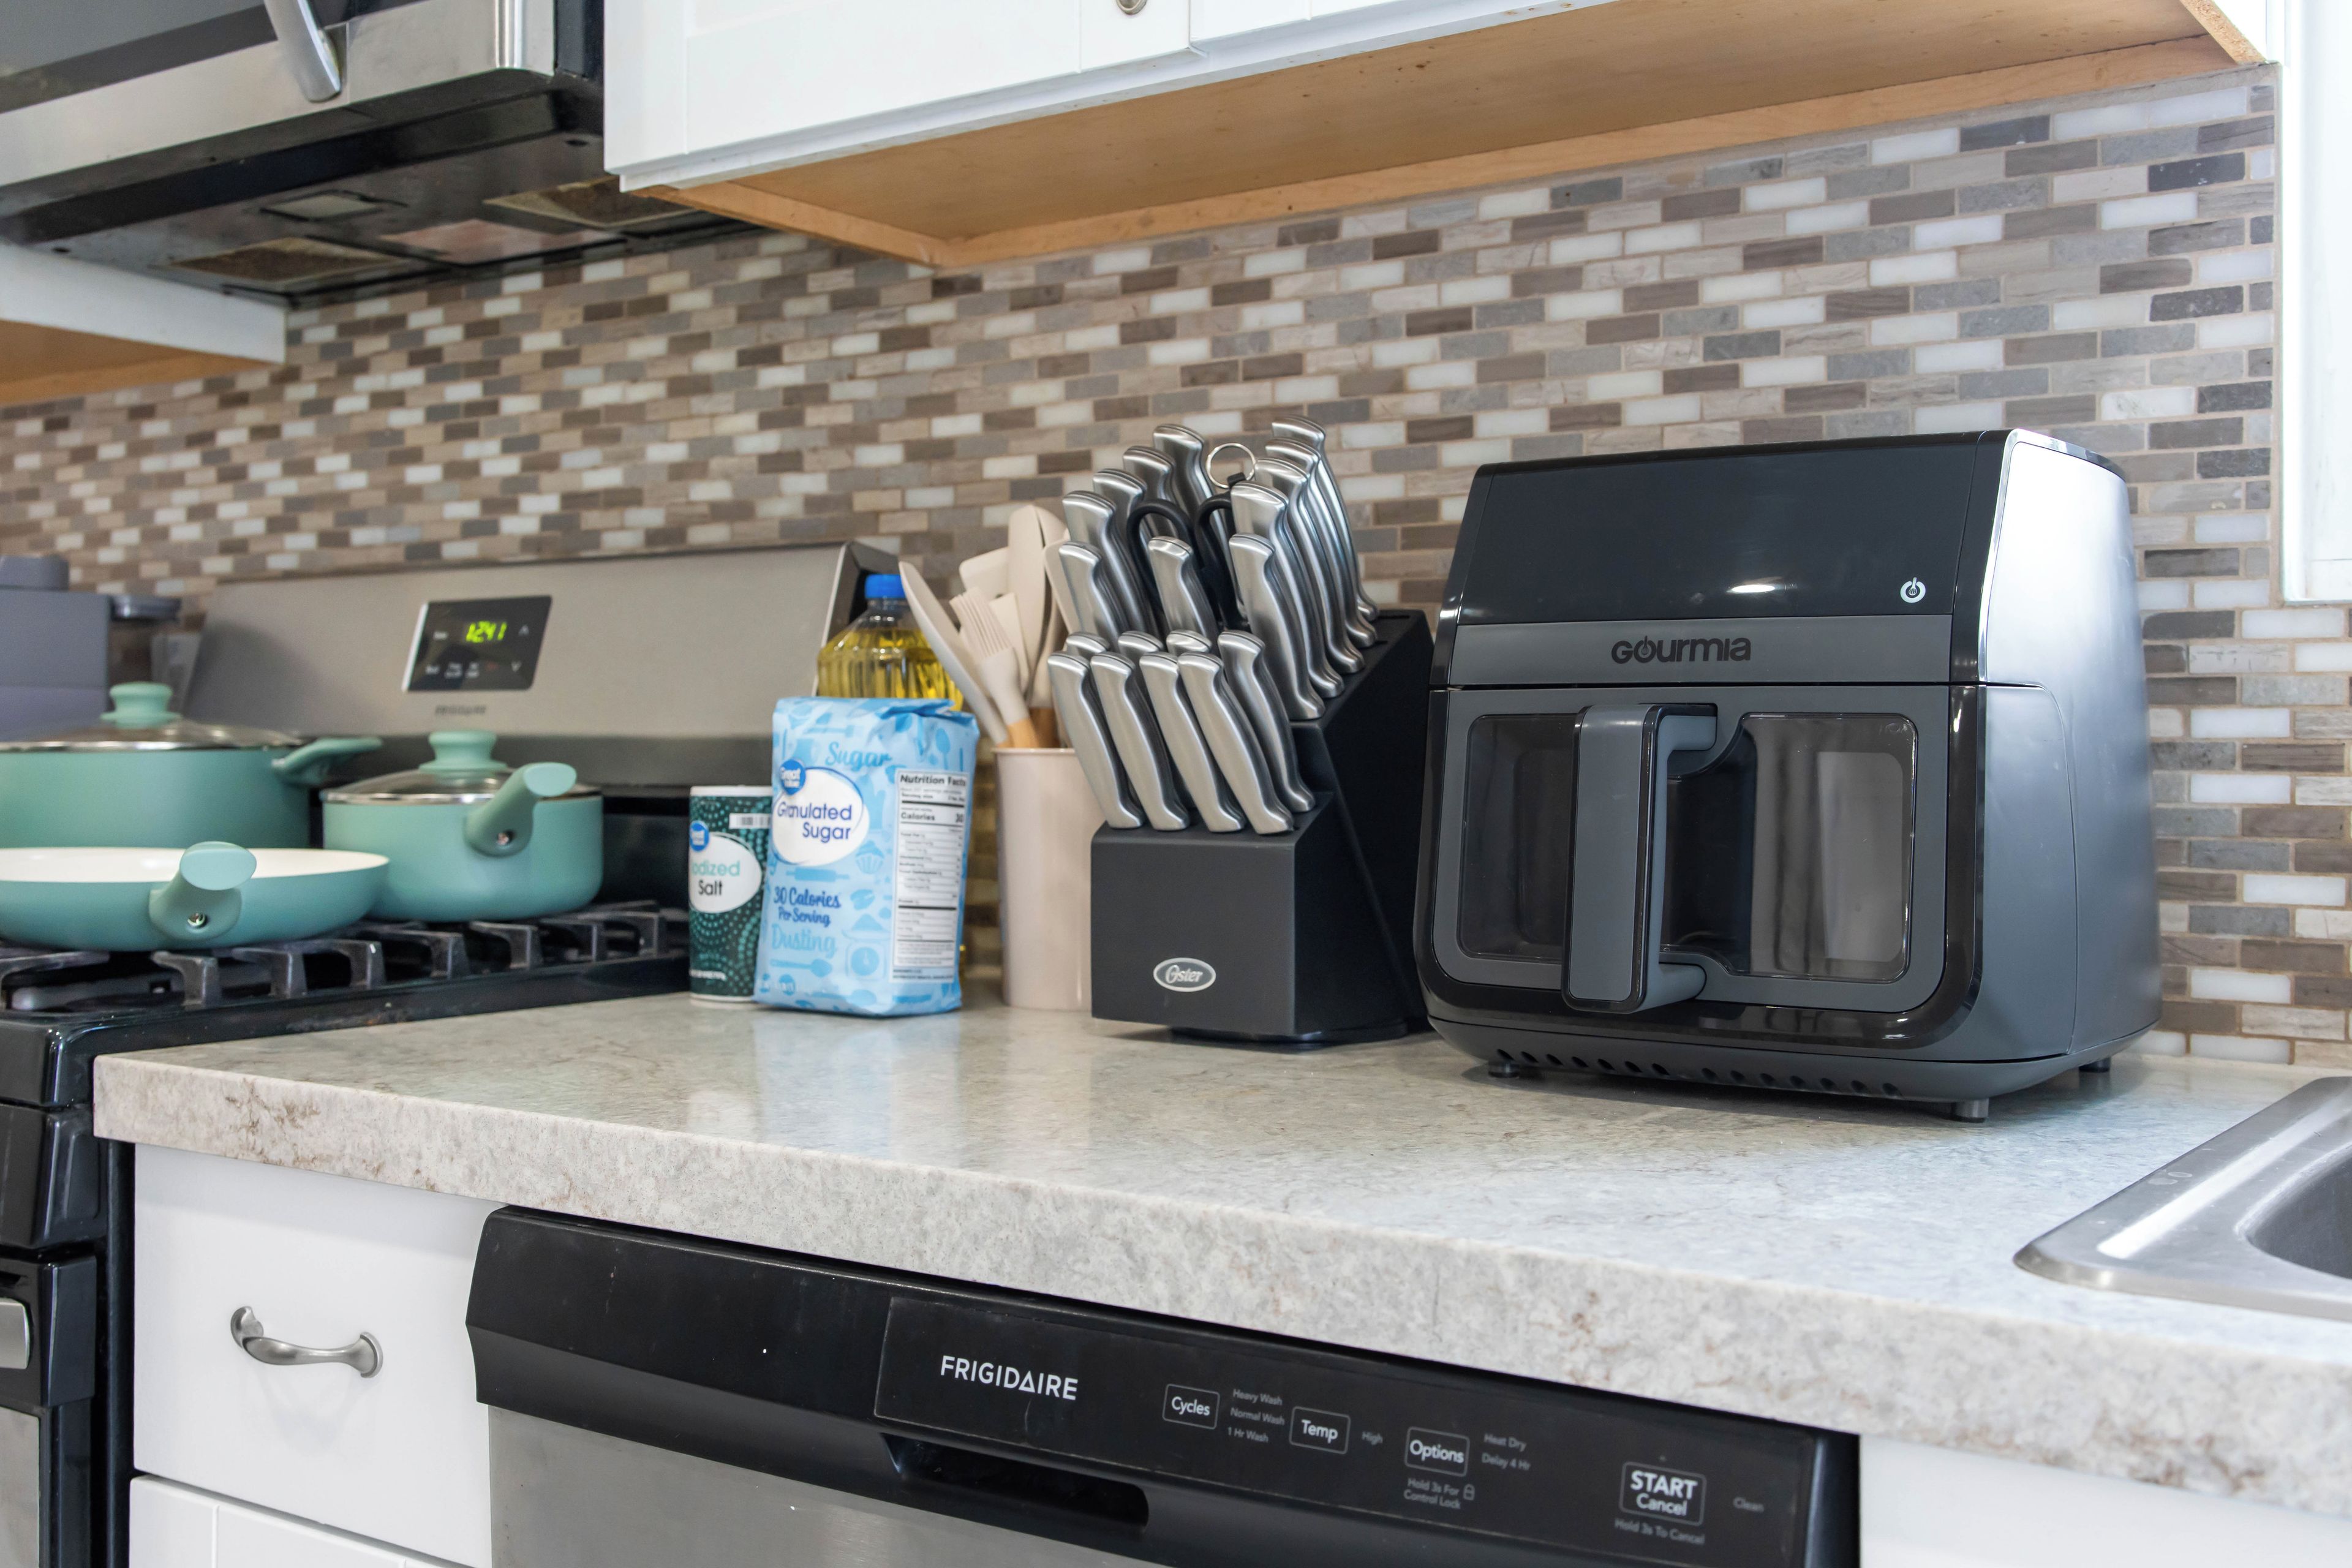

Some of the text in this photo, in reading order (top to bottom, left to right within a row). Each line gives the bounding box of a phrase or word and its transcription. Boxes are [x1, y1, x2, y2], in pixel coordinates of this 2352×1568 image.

[825, 742, 892, 772] Sugar
[900, 775, 966, 786] Nutrition Facts
[777, 801, 853, 821] Granulated
[901, 812, 935, 821] Calories
[802, 821, 851, 843] Sugar
[690, 859, 741, 877] odized
[698, 880, 723, 896] Salt
[774, 886, 841, 909] 30 Calories
[778, 907, 831, 927] Per Serving
[772, 923, 835, 959] Dusting
[1166, 964, 1204, 984] Oster
[941, 1355, 1079, 1400] FRIGIDAIRE
[1171, 1396, 1210, 1416] Cycles
[1233, 1389, 1283, 1406] Heavy Wash
[1230, 1407, 1286, 1426] Normal Wash
[1234, 1428, 1245, 1438] Hr
[1246, 1429, 1269, 1442] Wash
[1301, 1419, 1338, 1444] Temp
[1361, 1431, 1384, 1446] High
[1409, 1439, 1464, 1464] Options
[1483, 1433, 1528, 1452] Heat Dry
[1481, 1452, 1509, 1469] Delay
[1444, 1484, 1460, 1496] For
[1630, 1469, 1698, 1500] START
[1403, 1488, 1461, 1510] Control Lock
[1636, 1492, 1687, 1517] Cancel
[1733, 1496, 1765, 1513] Clean
[1669, 1528, 1706, 1546] Cancel
